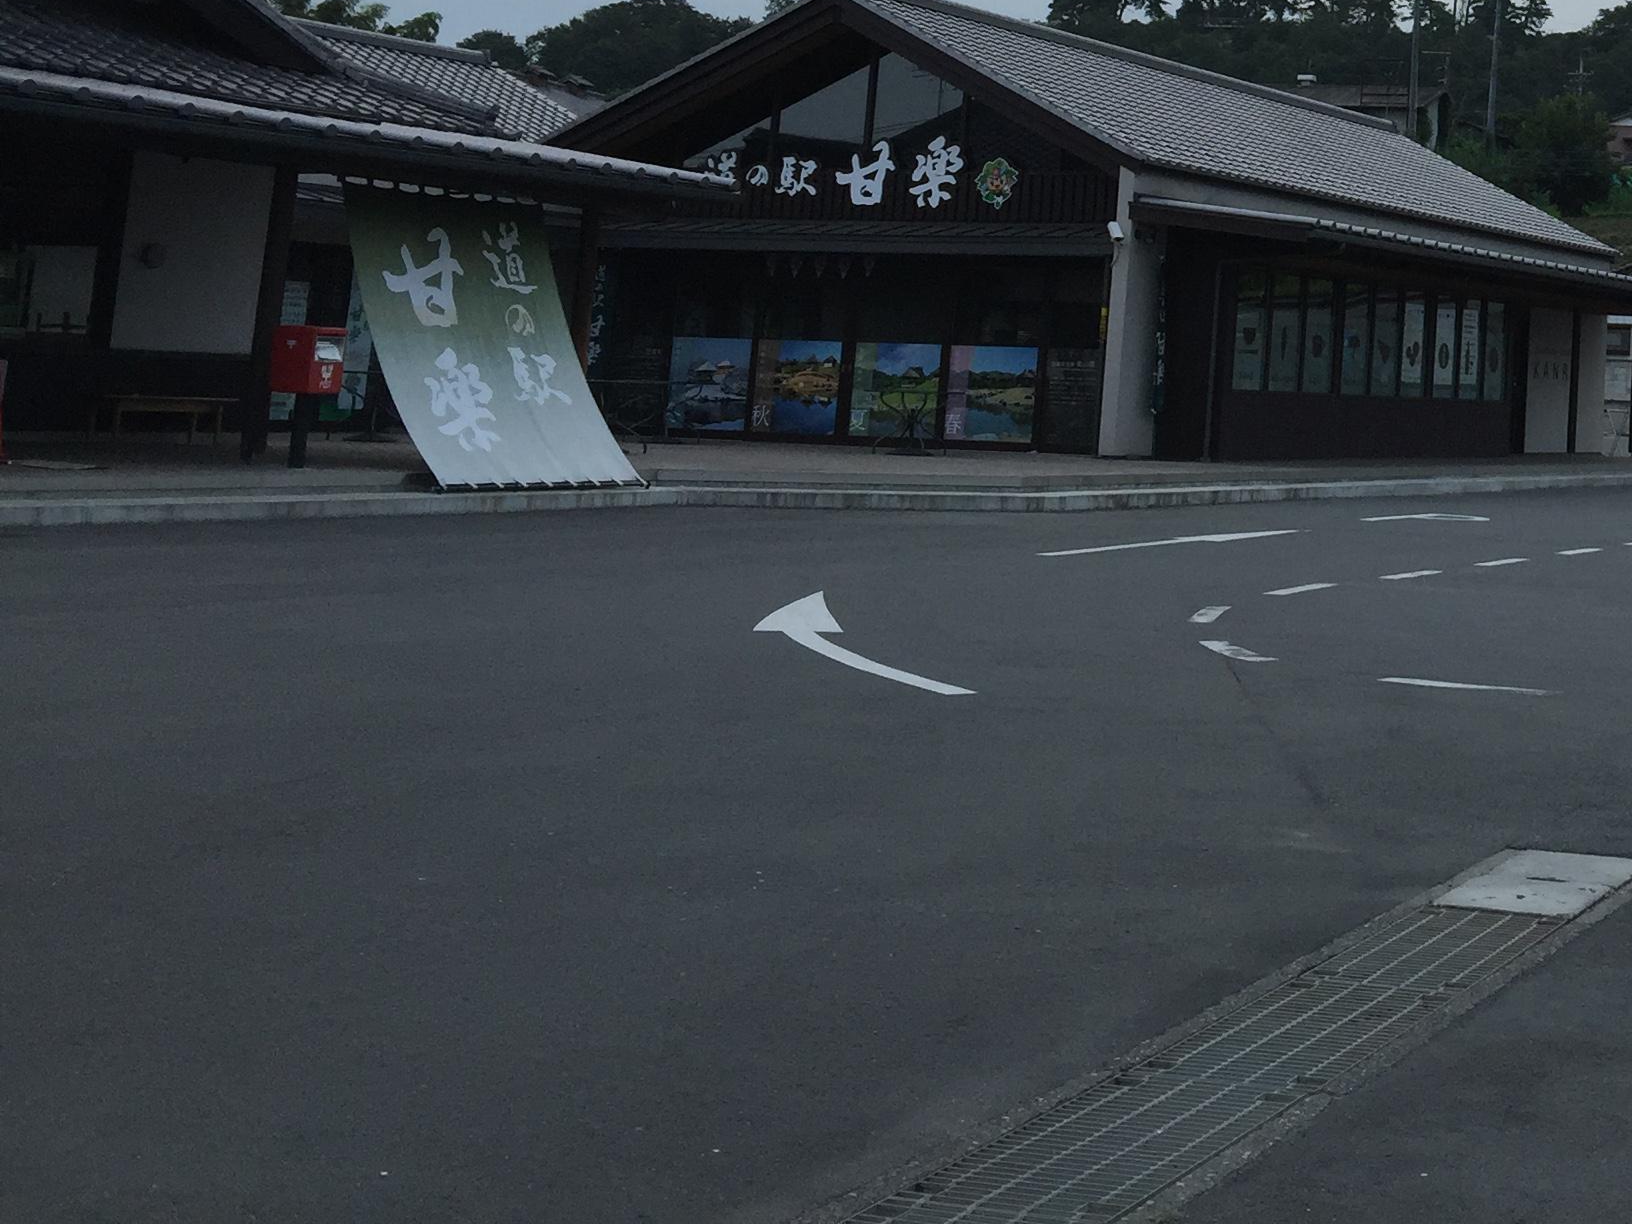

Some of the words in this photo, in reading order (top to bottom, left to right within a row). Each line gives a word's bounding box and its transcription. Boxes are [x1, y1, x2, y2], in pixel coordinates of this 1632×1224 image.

[835, 135, 966, 209] 甘楽
[382, 227, 501, 452] 甘楽
[481, 222, 572, 406] 道の駅
[751, 405, 770, 427] 秋
